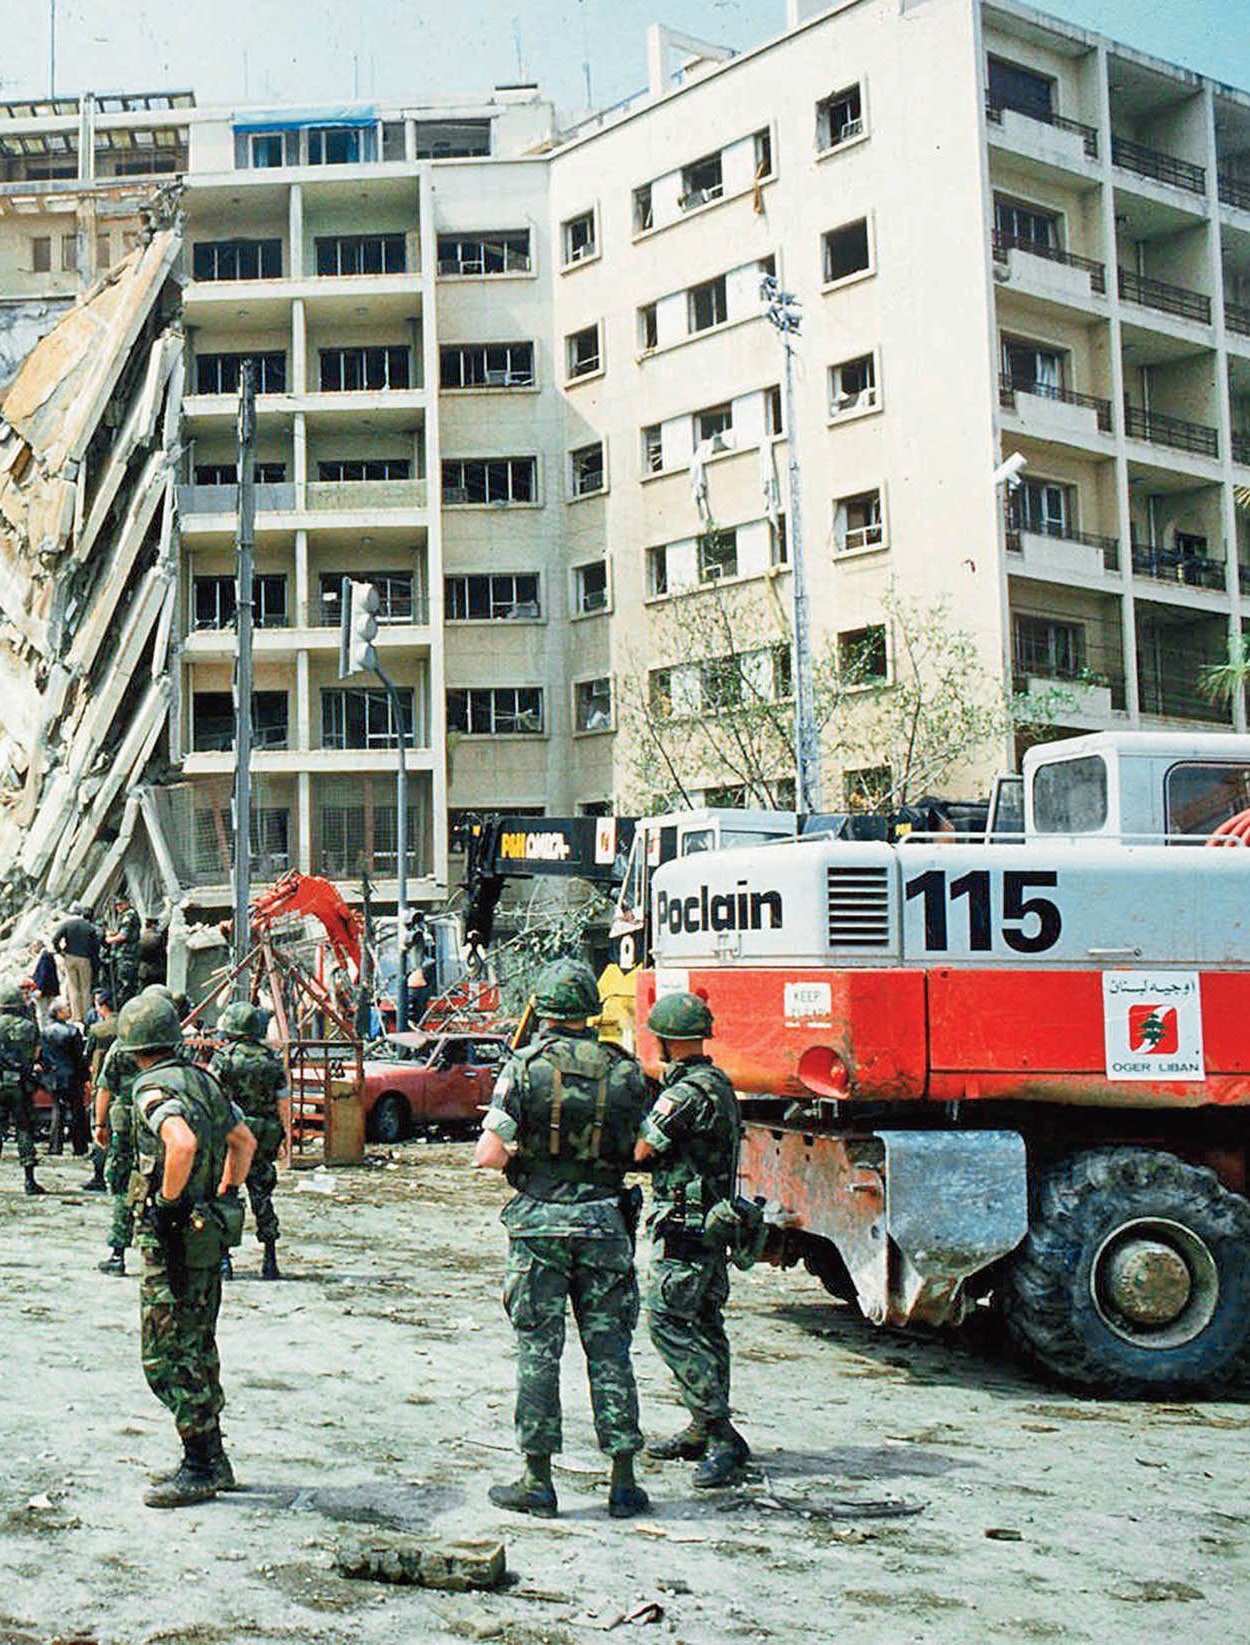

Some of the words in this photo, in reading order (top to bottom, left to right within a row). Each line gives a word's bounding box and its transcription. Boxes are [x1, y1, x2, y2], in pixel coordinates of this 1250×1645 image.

[657, 880, 782, 935] Poclain
[906, 870, 1062, 953] 115
[1112, 1062, 1151, 1072] OGER
[1158, 1062, 1199, 1072] LIBAN
